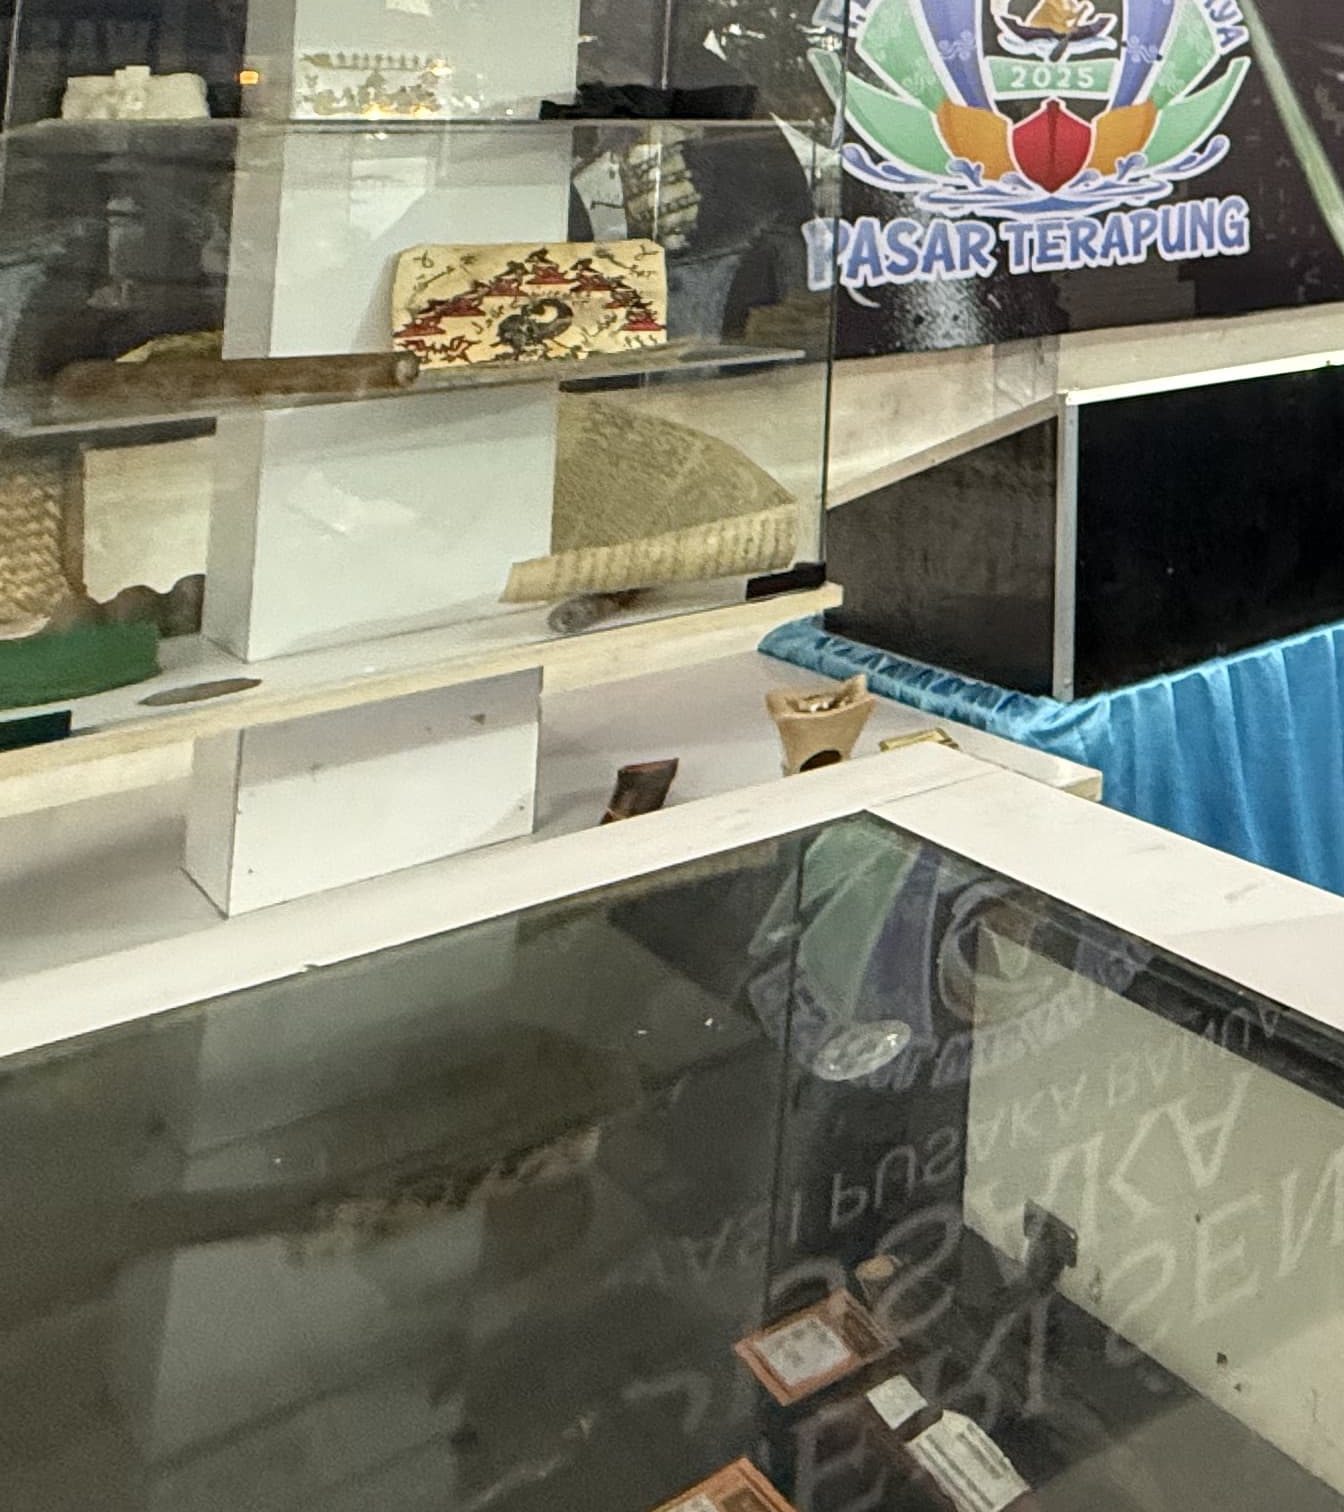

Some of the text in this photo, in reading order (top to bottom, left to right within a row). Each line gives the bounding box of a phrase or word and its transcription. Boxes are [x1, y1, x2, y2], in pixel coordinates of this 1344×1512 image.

[1010, 64, 1095, 89] 2025
[805, 198, 1248, 288] PASAR TERAPUNG
